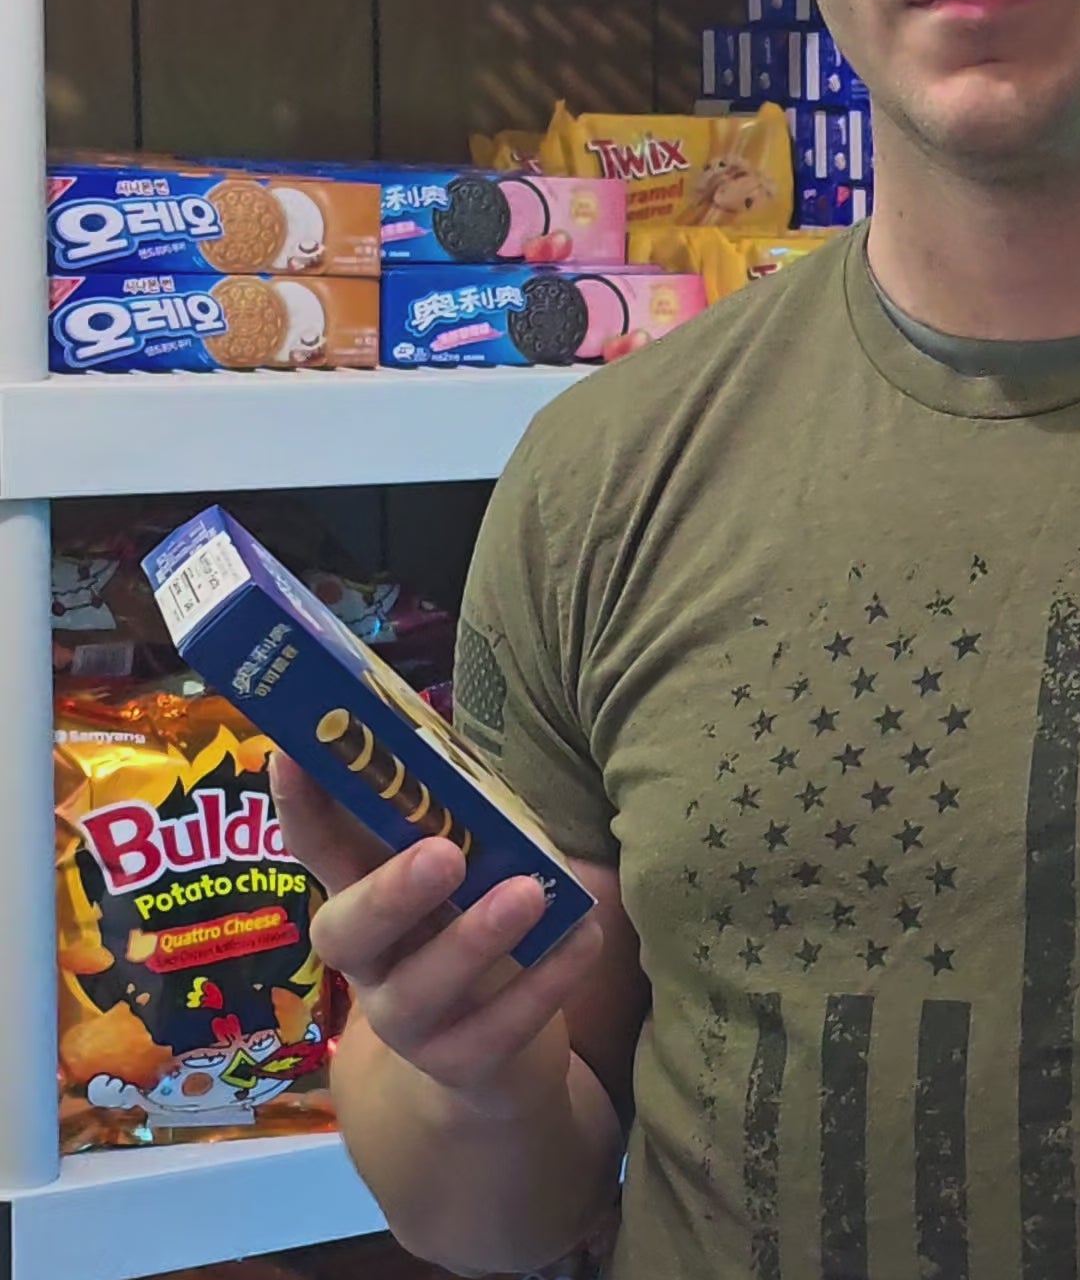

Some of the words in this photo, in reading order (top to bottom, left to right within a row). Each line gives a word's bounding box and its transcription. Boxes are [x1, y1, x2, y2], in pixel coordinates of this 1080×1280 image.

[56, 200, 220, 261] 오레오
[65, 296, 224, 359] 오레오
[134, 877, 232, 920] Potato
[236, 868, 306, 897] chips
[160, 926, 221, 951] Quattro
[223, 913, 281, 937] Cheese
